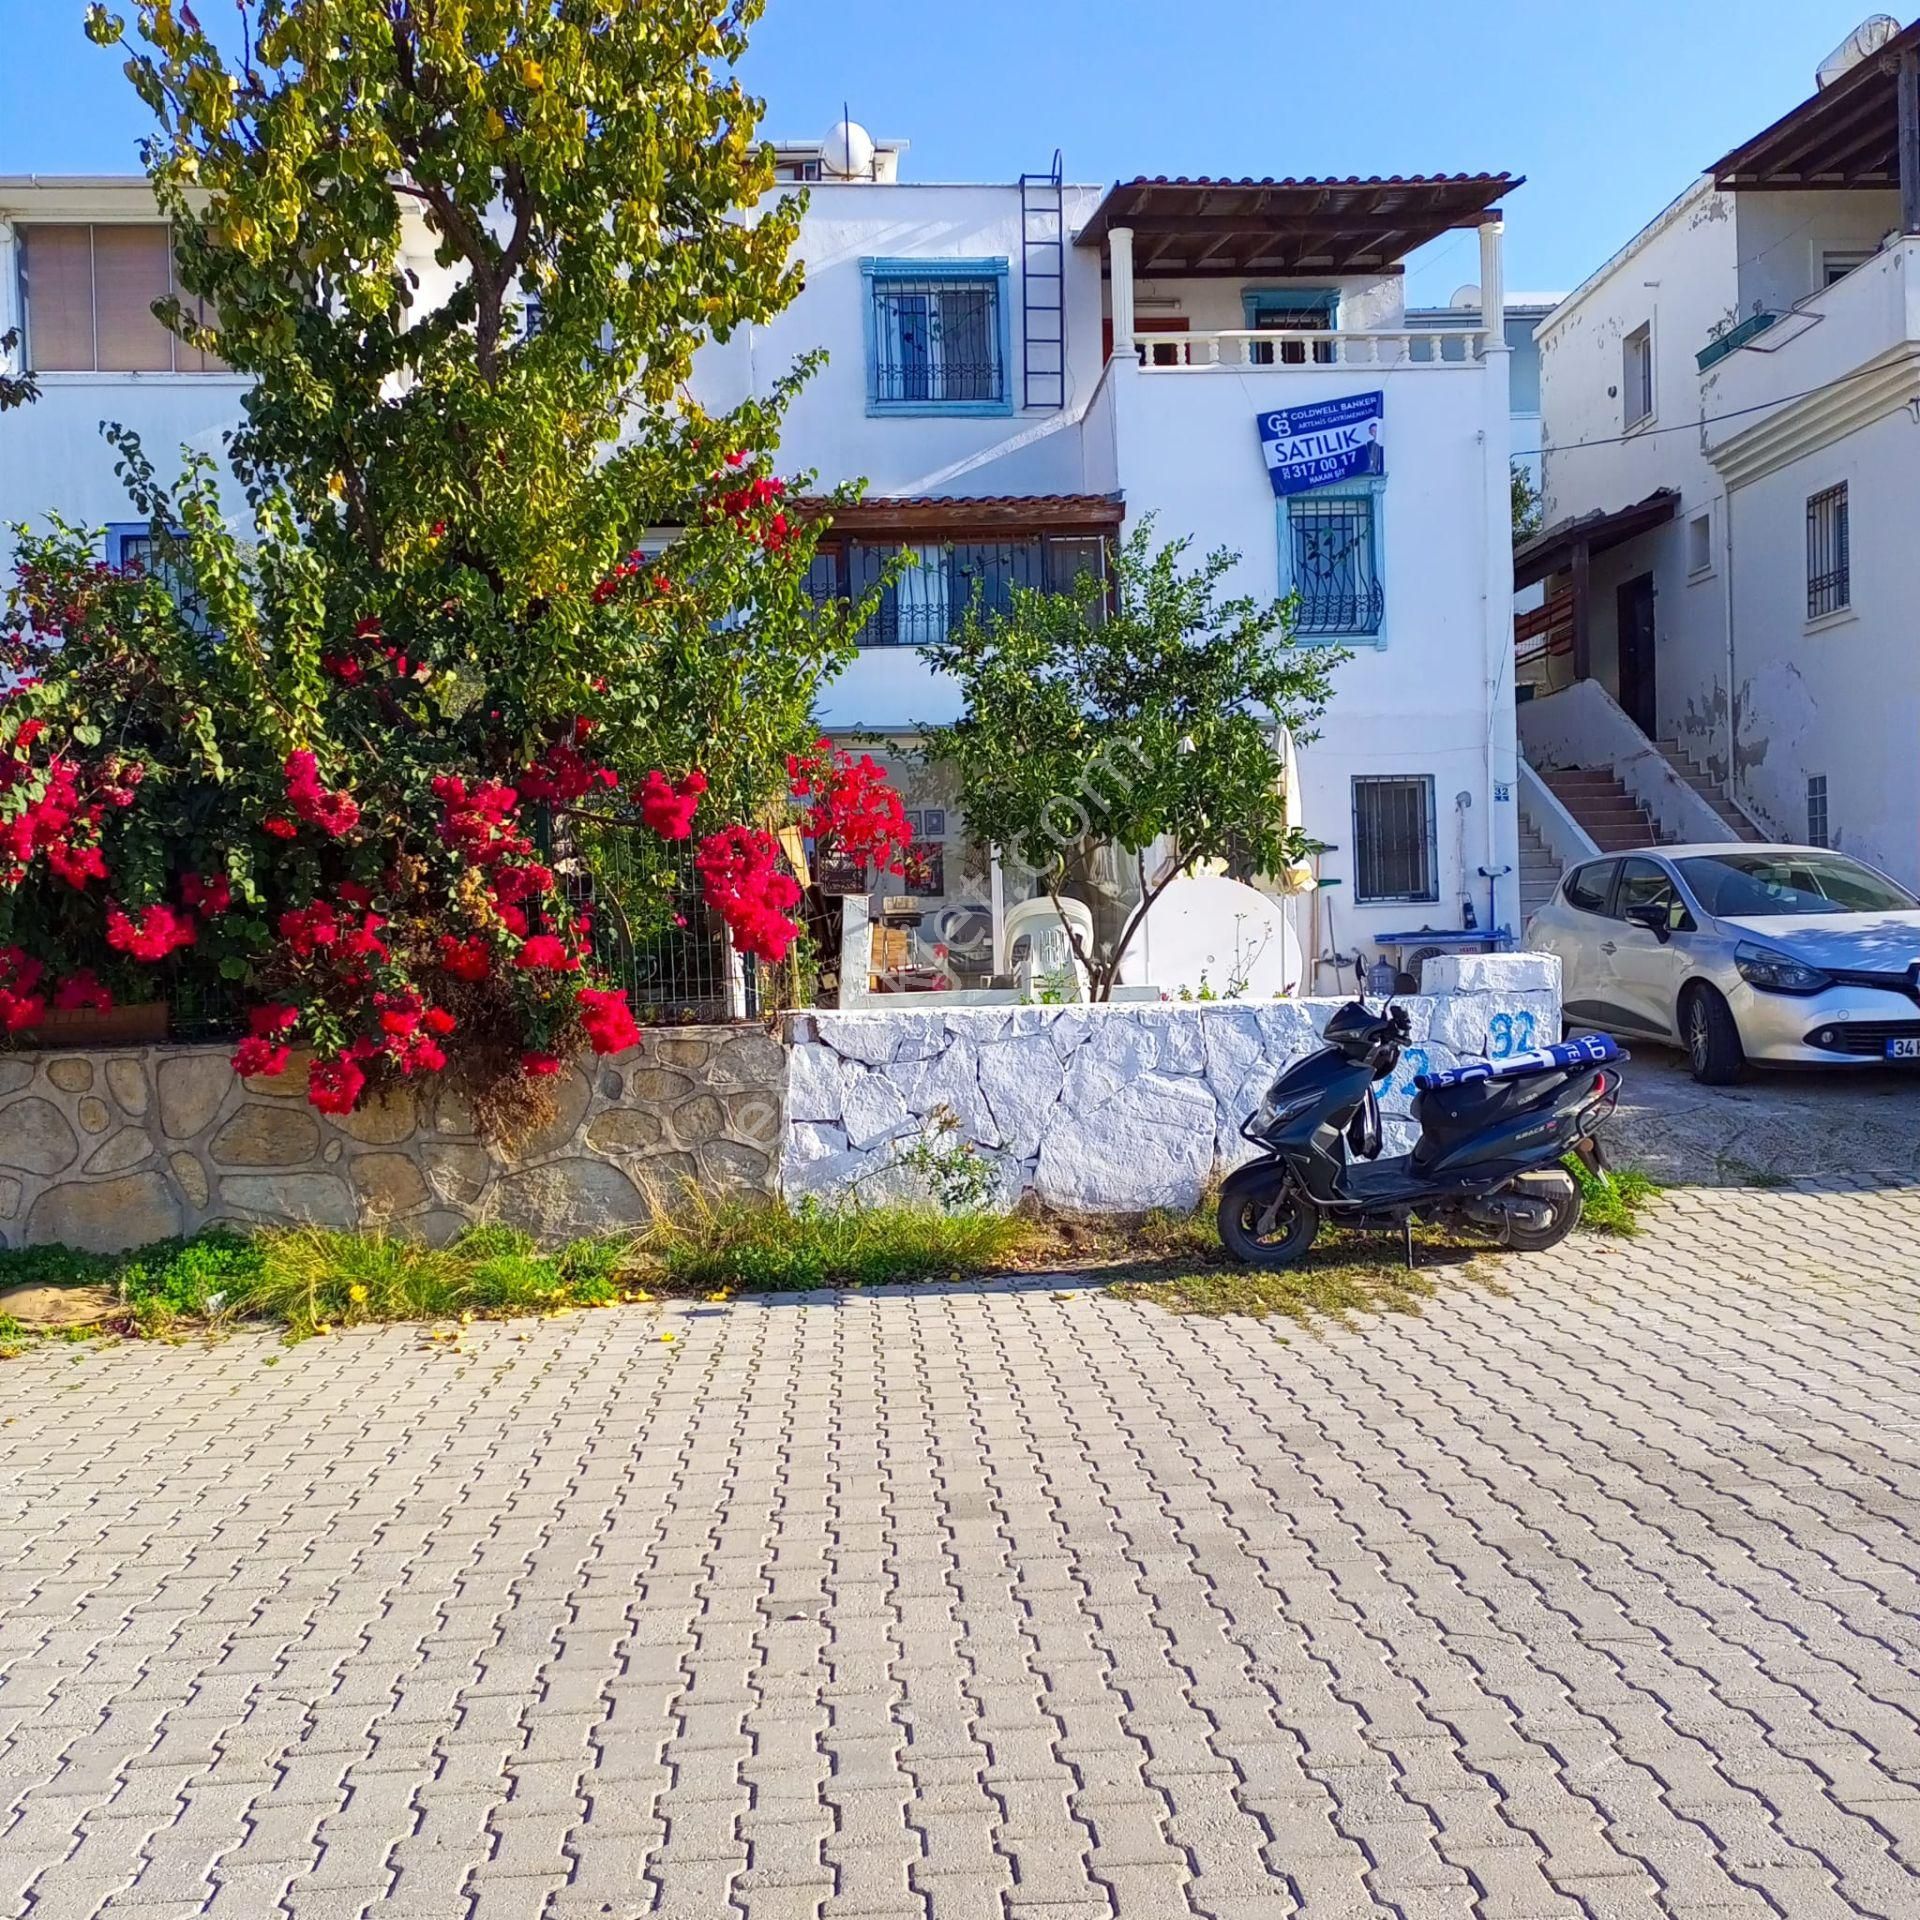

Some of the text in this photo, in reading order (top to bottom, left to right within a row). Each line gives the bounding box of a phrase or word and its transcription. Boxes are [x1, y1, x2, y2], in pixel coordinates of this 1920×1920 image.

[1290, 397, 1377, 421] COLDWELL BANKER
[1275, 428, 1361, 463] SATILIK
[1292, 462, 1316, 478] 317
[1320, 457, 1338, 472] 00
[1340, 451, 1357, 466] 17
[1309, 471, 1334, 484] HAKAN
[1494, 787, 1509, 796] 32
[1895, 1041, 1914, 1056] 34
